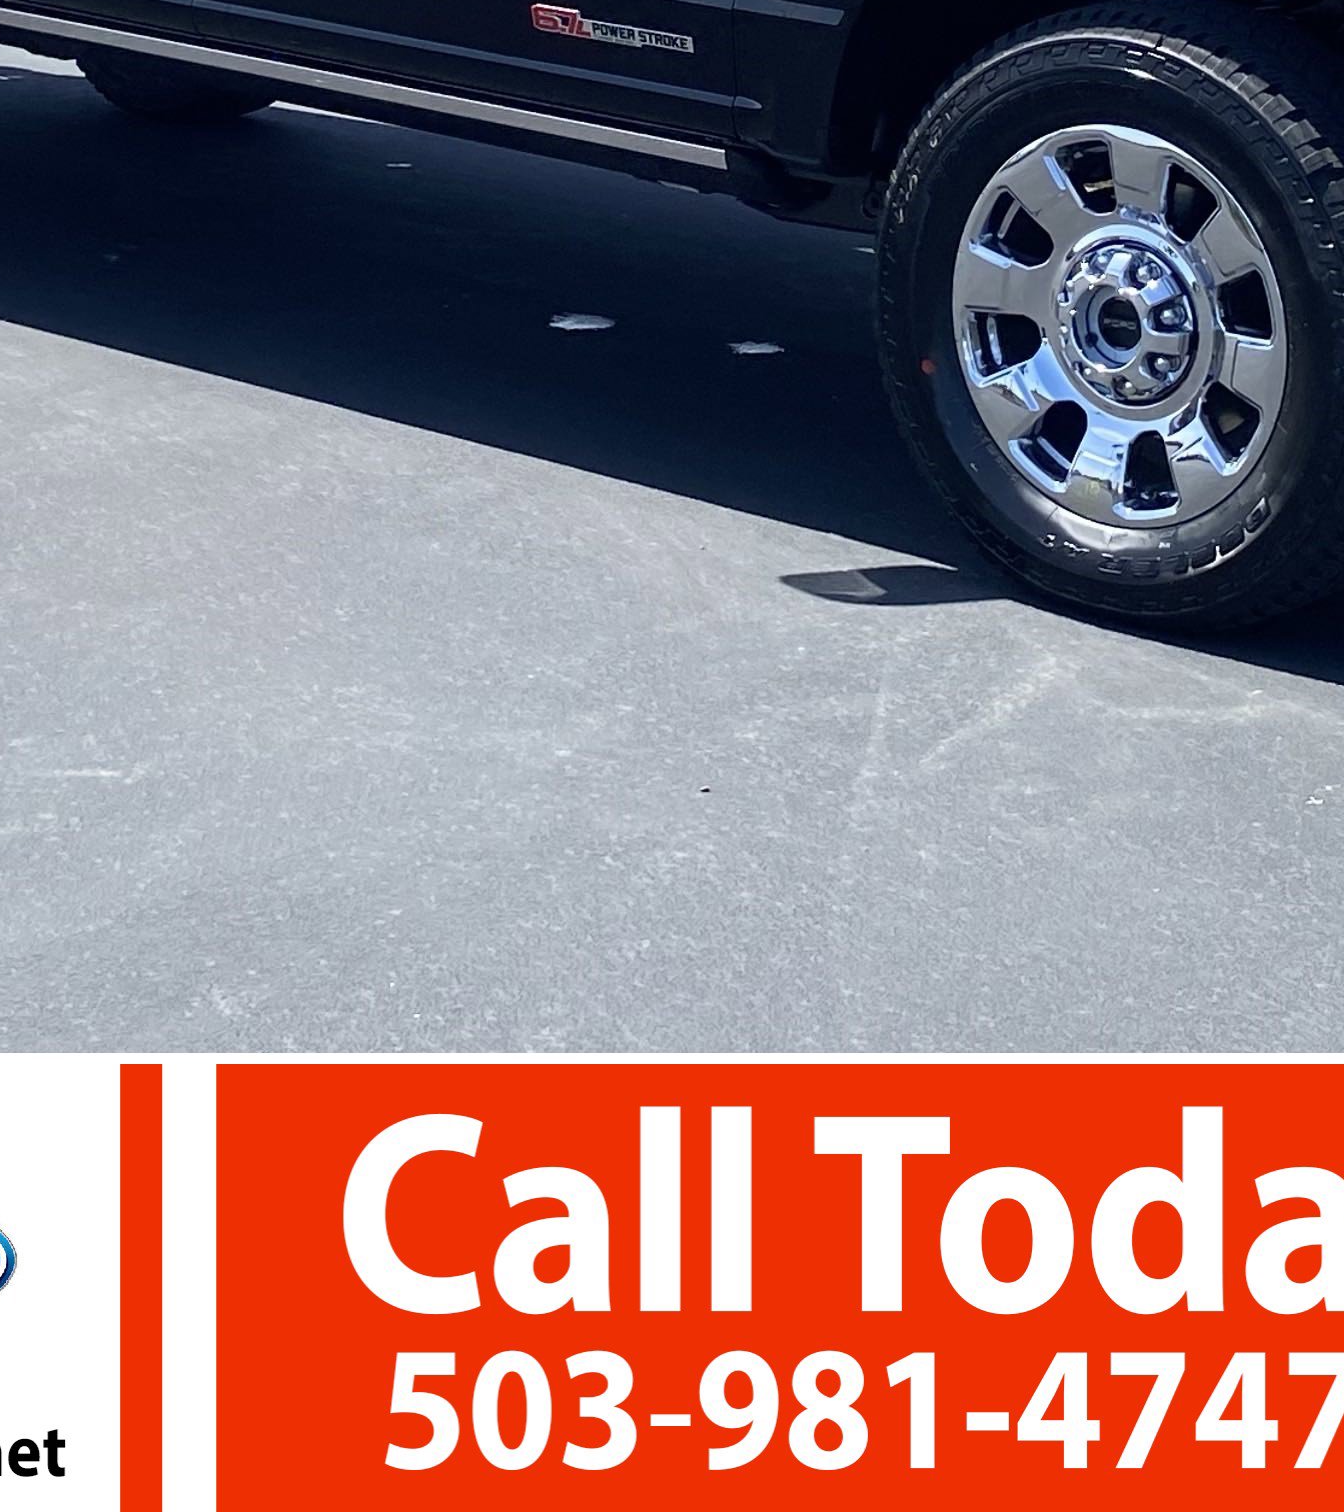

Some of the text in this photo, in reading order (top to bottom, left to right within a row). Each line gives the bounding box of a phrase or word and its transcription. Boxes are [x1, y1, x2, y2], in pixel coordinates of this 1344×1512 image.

[532, 4, 592, 38] 6.7L
[591, 22, 636, 42] POWER
[637, 31, 690, 51] STROKE
